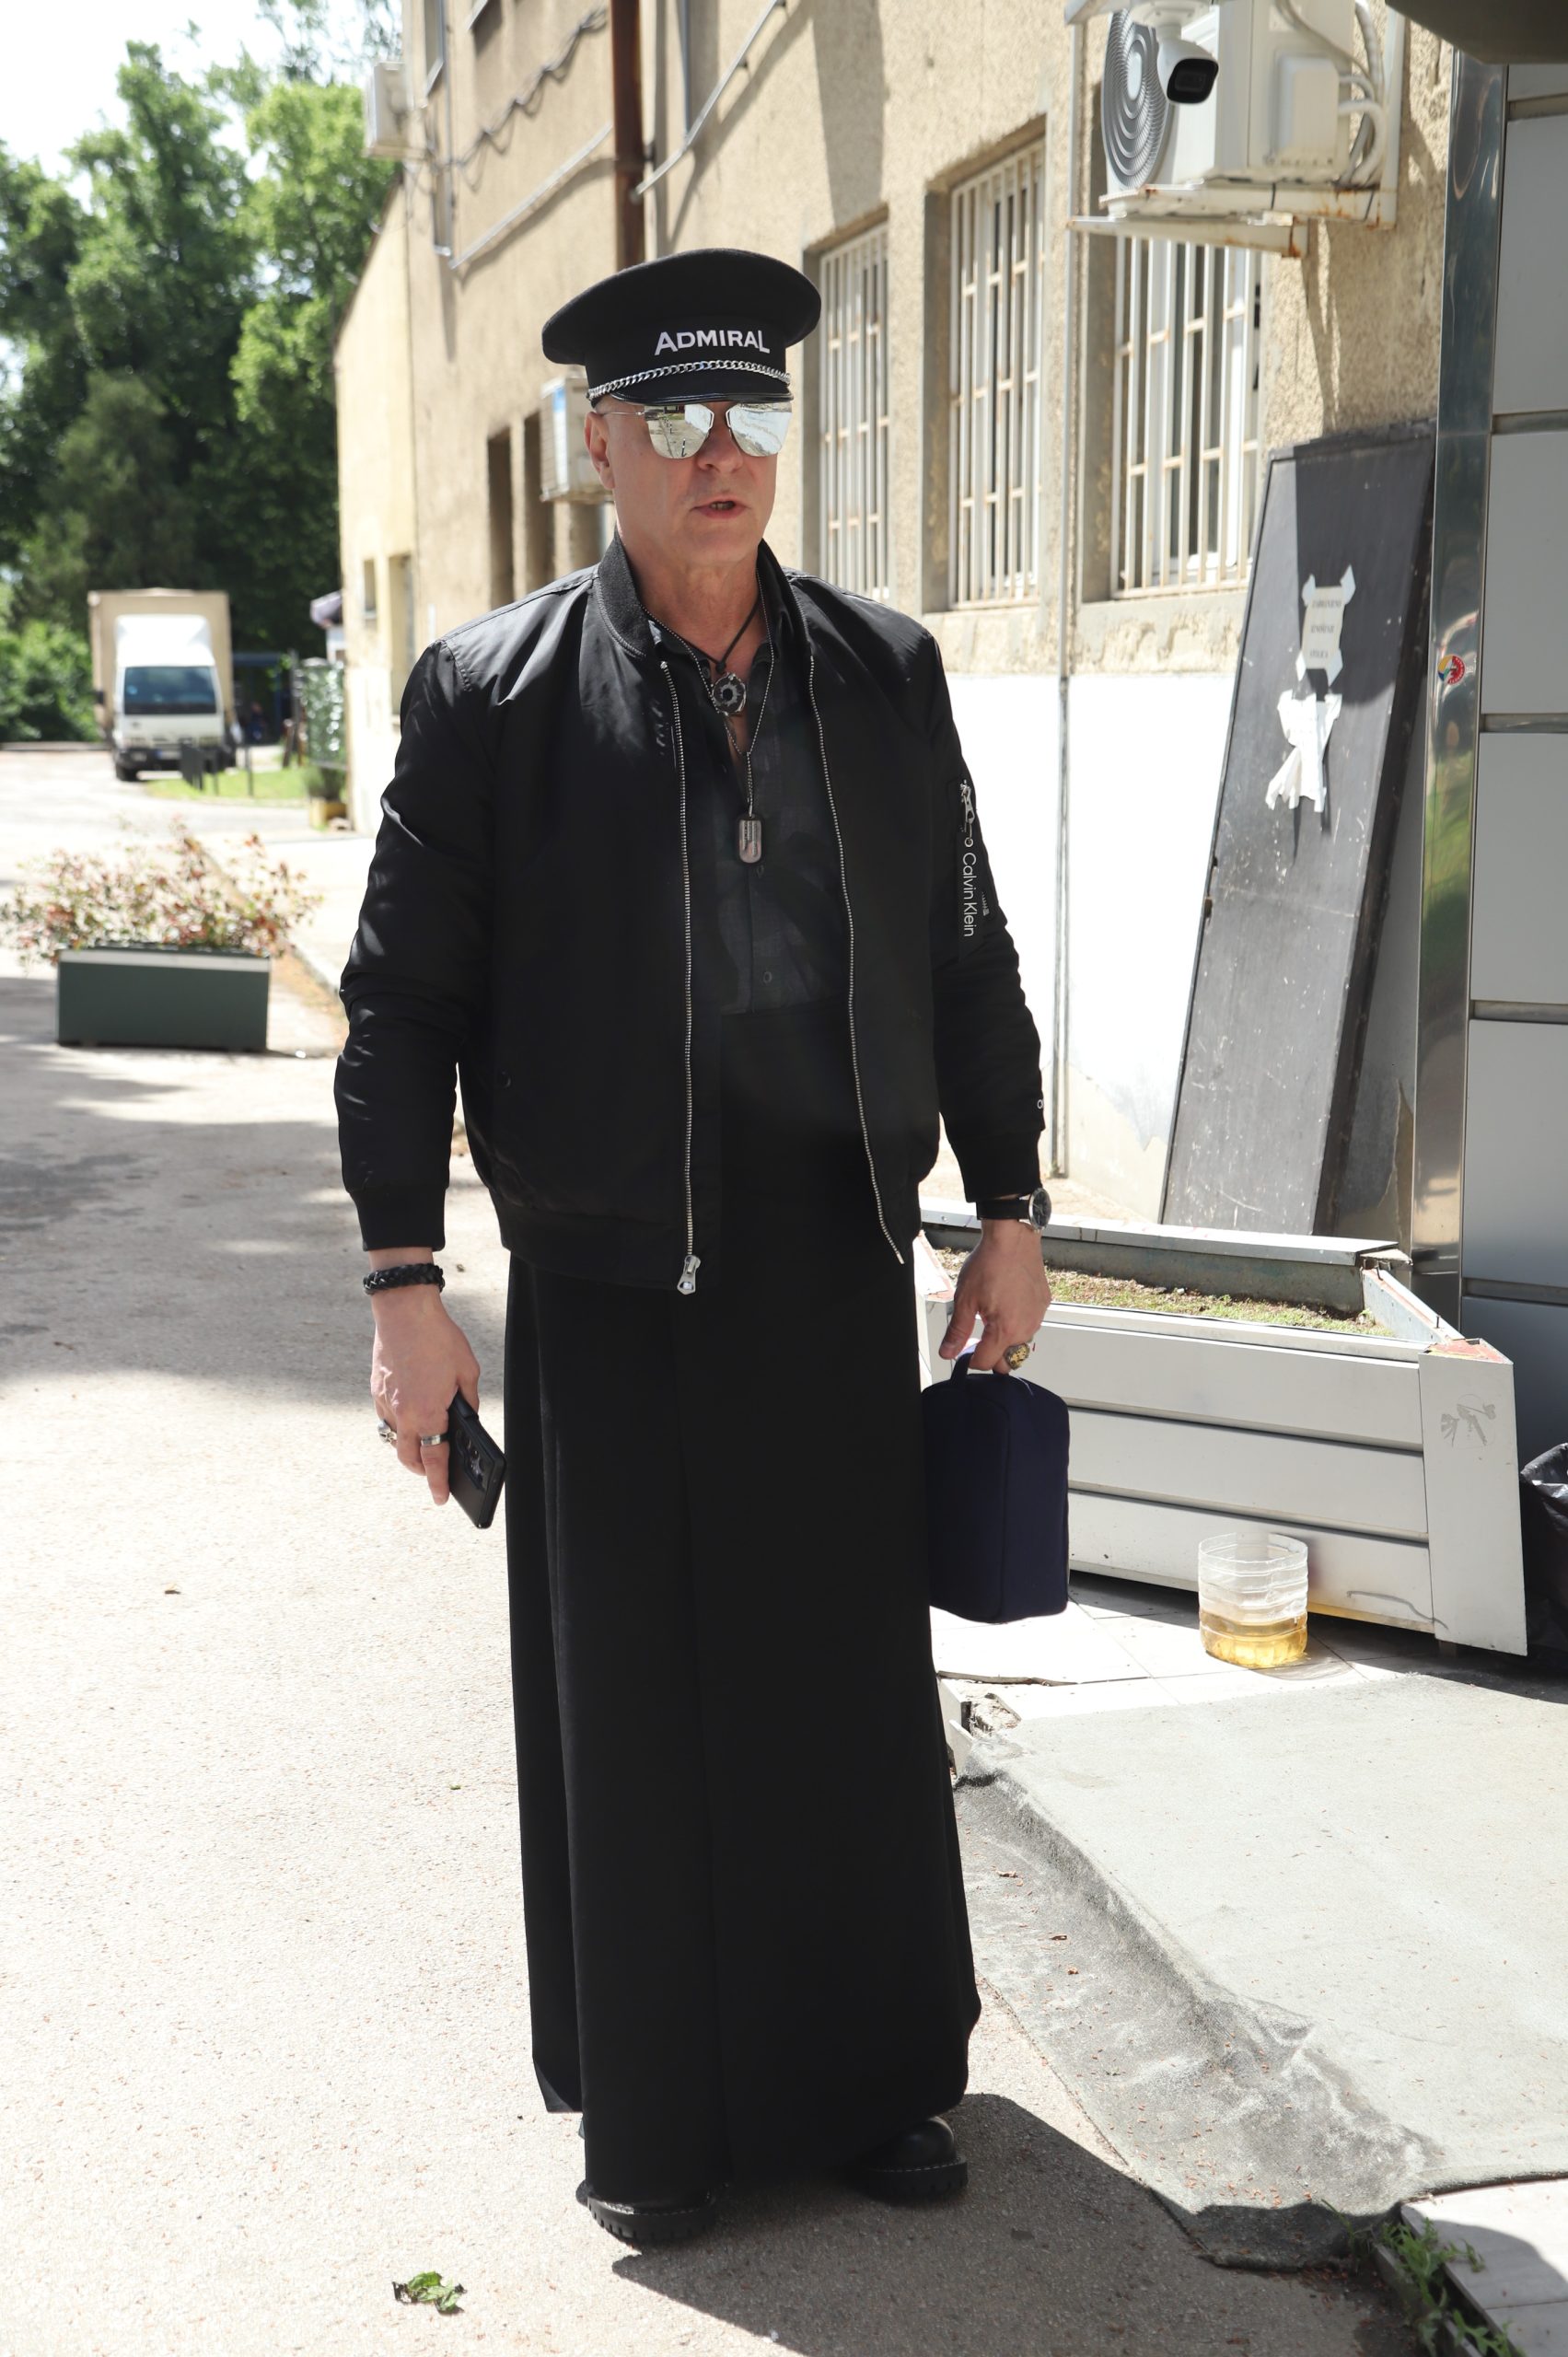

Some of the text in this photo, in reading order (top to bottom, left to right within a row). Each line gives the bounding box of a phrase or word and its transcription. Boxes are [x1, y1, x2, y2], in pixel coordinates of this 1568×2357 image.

[654, 330, 771, 356] ADMIRAL
[962, 852, 978, 937] Calvin Klein
